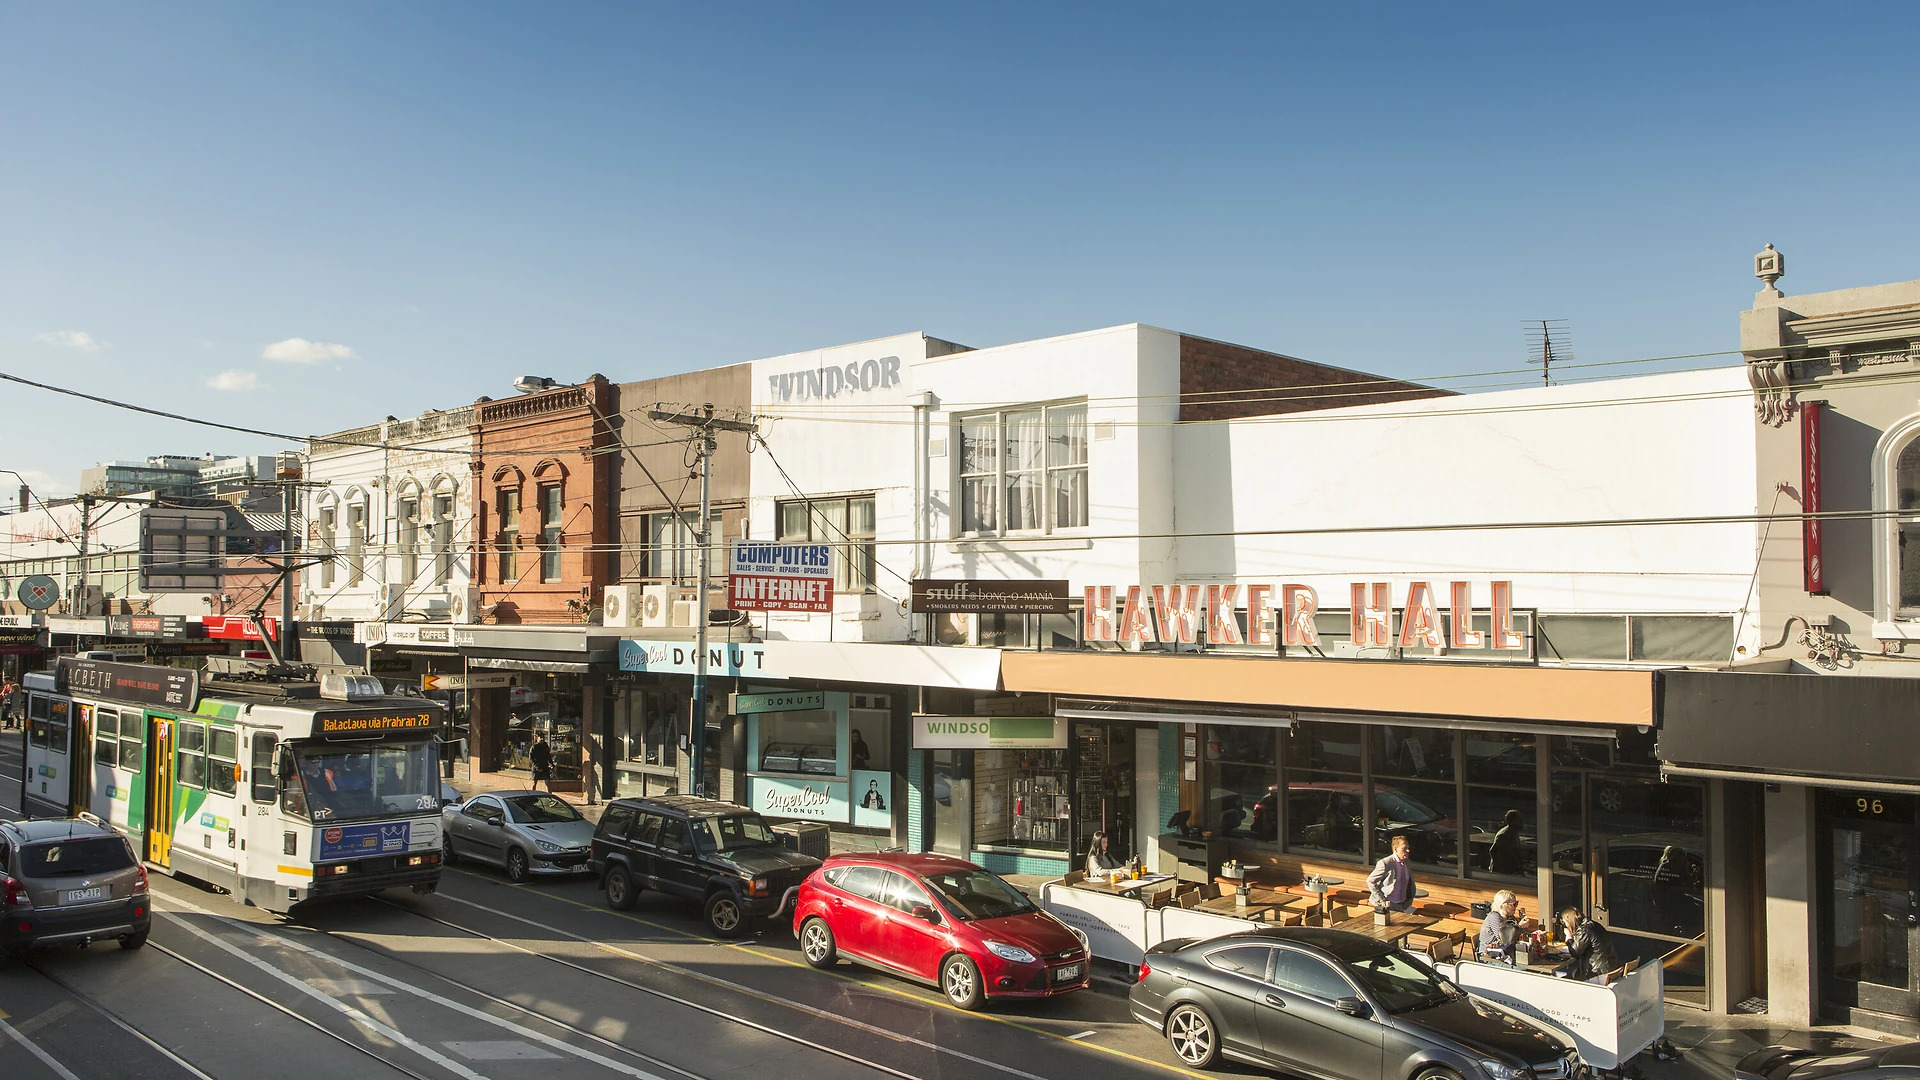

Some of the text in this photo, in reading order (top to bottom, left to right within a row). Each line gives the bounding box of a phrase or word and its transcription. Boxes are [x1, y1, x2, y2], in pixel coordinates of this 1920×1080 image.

[769, 356, 901, 404] WINDSOR
[737, 544, 829, 567] COMPUTERS
[756, 565, 775, 573] SERVICE
[804, 567, 829, 575] UPGRADES
[735, 577, 828, 602] INTERNET
[1084, 580, 1524, 650] HAWKER HALL
[768, 696, 820, 706] DONUTS
[323, 714, 430, 731] Balaclava via Prahran 78
[257, 806, 269, 816] 284
[416, 798, 438, 810] 284
[787, 807, 825, 815] DONUTS
[1857, 798, 1883, 814] 96
[1511, 1002, 1530, 1010] HALL
[1541, 1007, 1561, 1016] FOOD
[1573, 1014, 1592, 1022] TAPS
